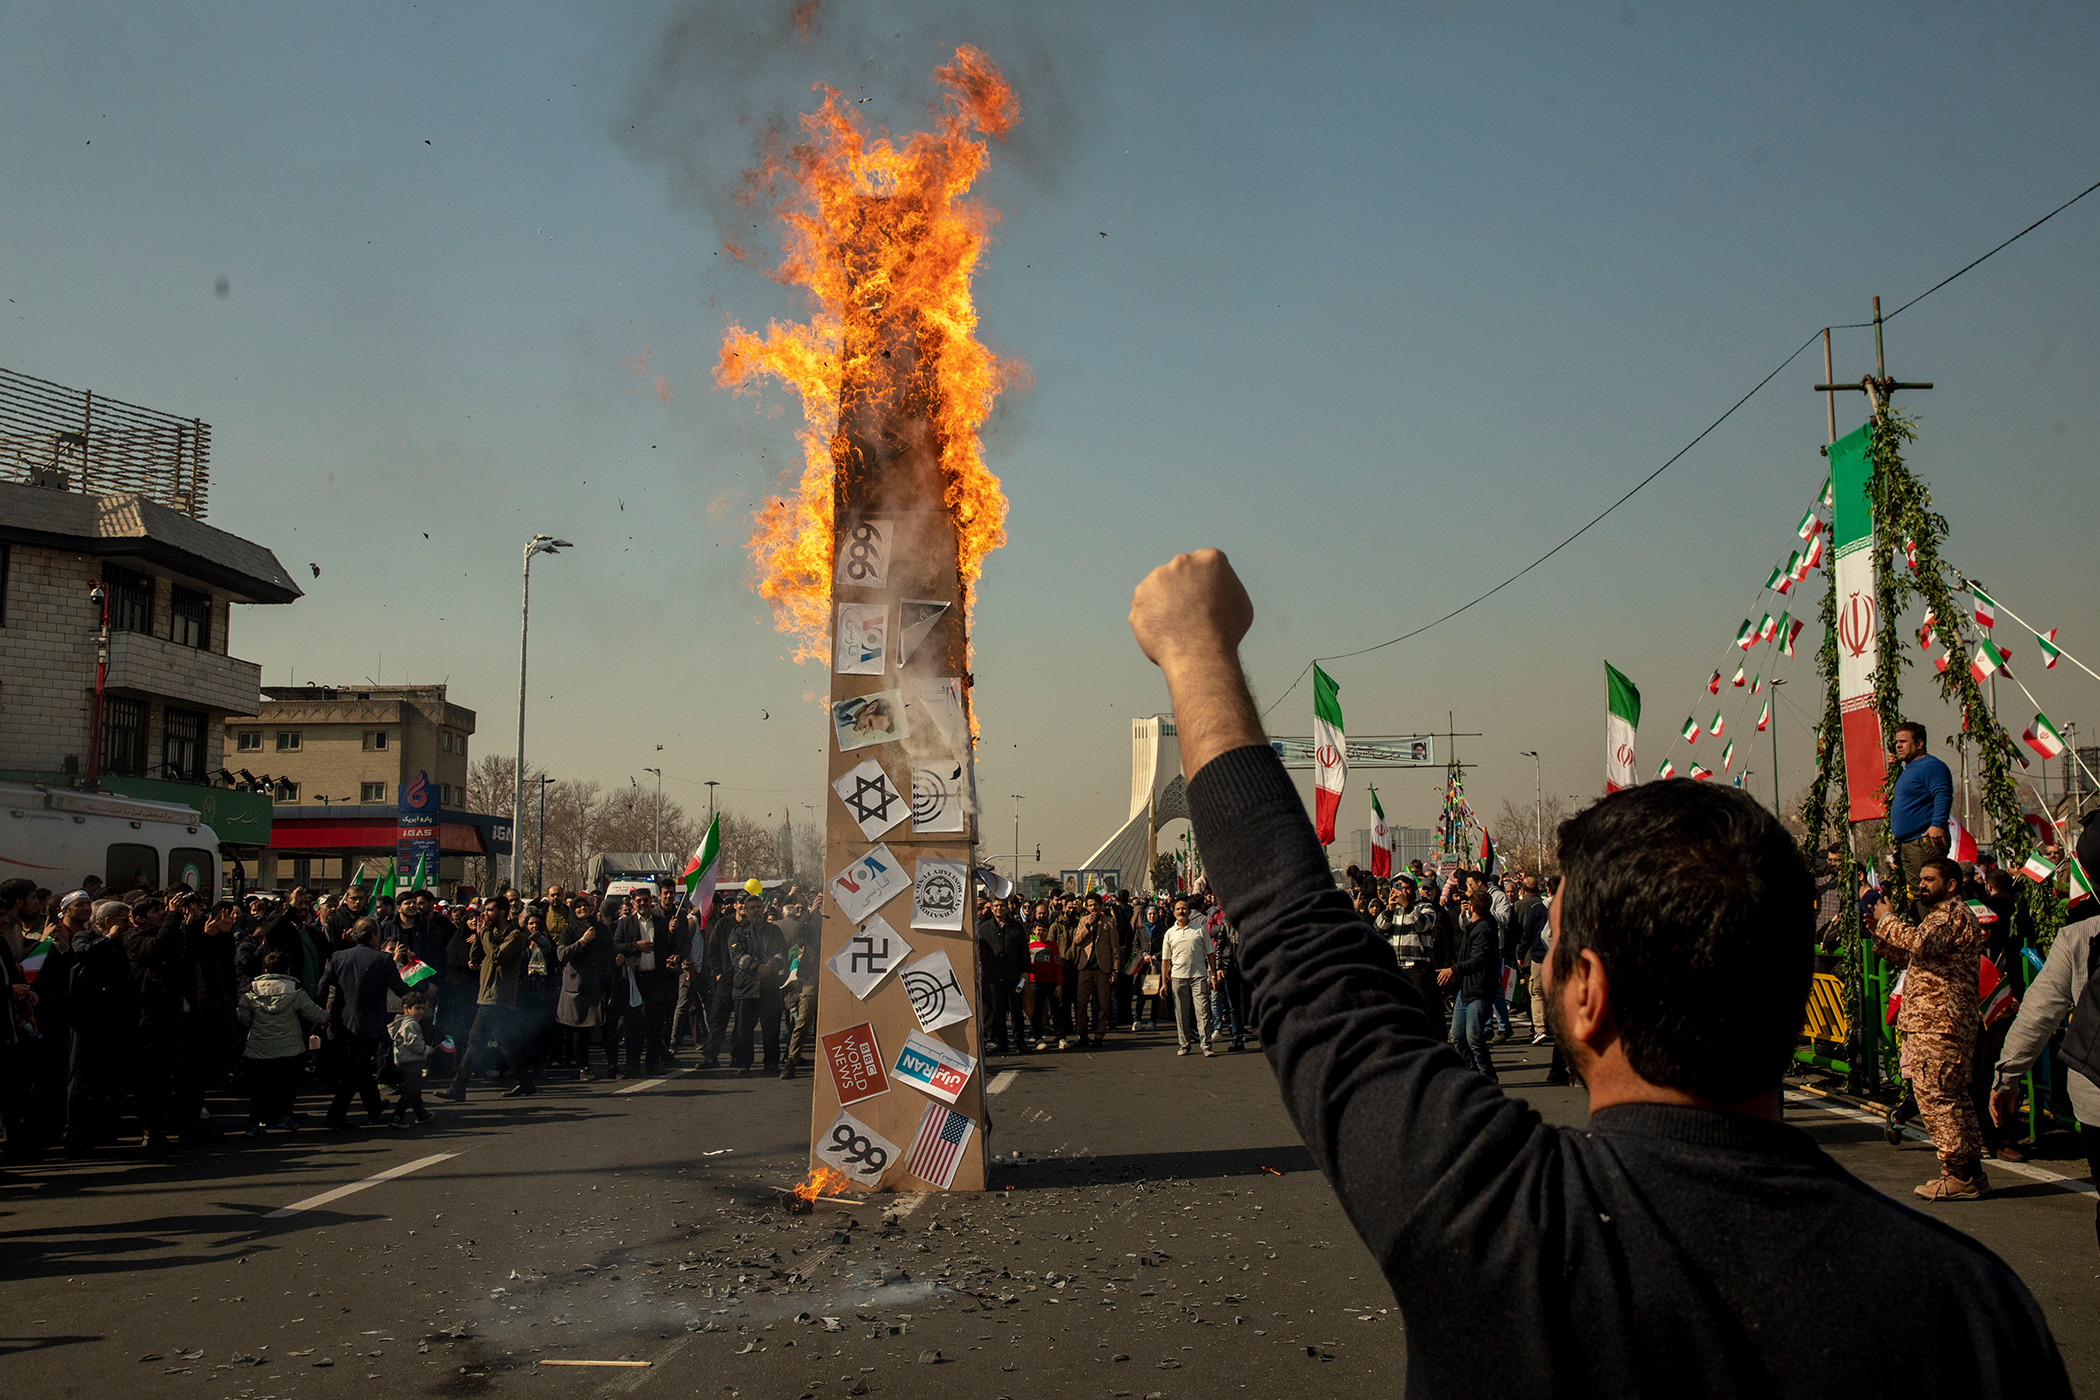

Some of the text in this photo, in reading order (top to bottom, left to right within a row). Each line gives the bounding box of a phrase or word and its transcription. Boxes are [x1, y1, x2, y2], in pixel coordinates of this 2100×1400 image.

[836, 856, 888, 893] VOA
[860, 875, 890, 908] فارسی
[915, 868, 963, 919] INTERNATIONAL MONETARY FUND
[832, 1045, 854, 1089] NEWS
[843, 1035, 868, 1091] WORLD
[860, 1042, 878, 1077] BBC
